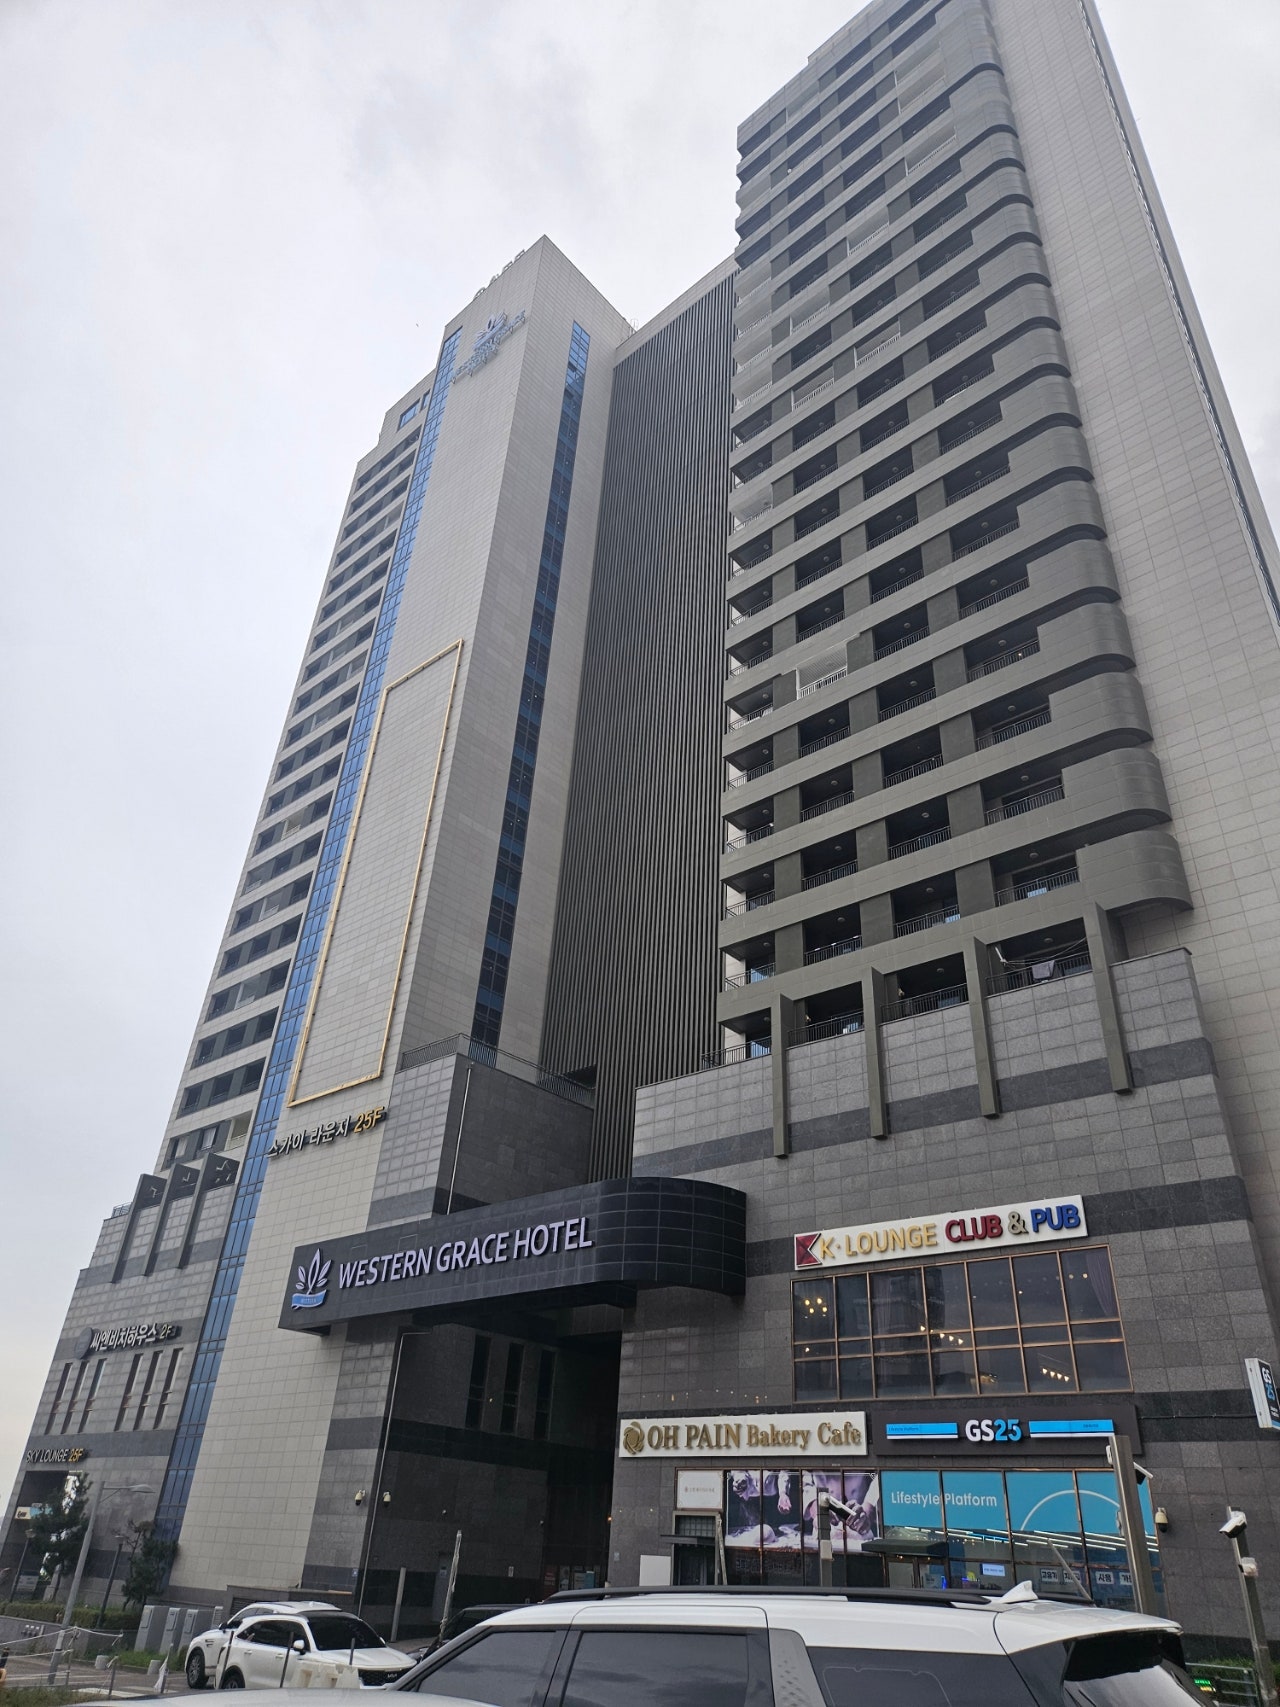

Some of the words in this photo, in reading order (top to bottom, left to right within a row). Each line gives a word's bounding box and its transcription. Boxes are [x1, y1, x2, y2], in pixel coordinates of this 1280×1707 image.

[266, 1130, 306, 1157] 스카이
[309, 1115, 351, 1145] 라운지
[354, 1106, 385, 1133] 25F
[945, 1214, 1003, 1243] CLUB
[1007, 1211, 1029, 1235] &
[1030, 1204, 1081, 1233] PUB
[338, 1246, 433, 1288] WESTERN
[436, 1232, 510, 1272] GRACE
[513, 1217, 592, 1259] HOTEL
[647, 1425, 680, 1449] OH
[685, 1423, 740, 1449] PAIN
[746, 1423, 810, 1450] Bakery
[817, 1421, 862, 1446] Cafe
[965, 1419, 1023, 1442] GS25
[27, 1450, 40, 1463] SKY
[40, 1449, 69, 1462] LOUNGE
[68, 1448, 84, 1462] 25F
[891, 1491, 940, 1508] Lifestyle
[944, 1493, 997, 1507] Platform
